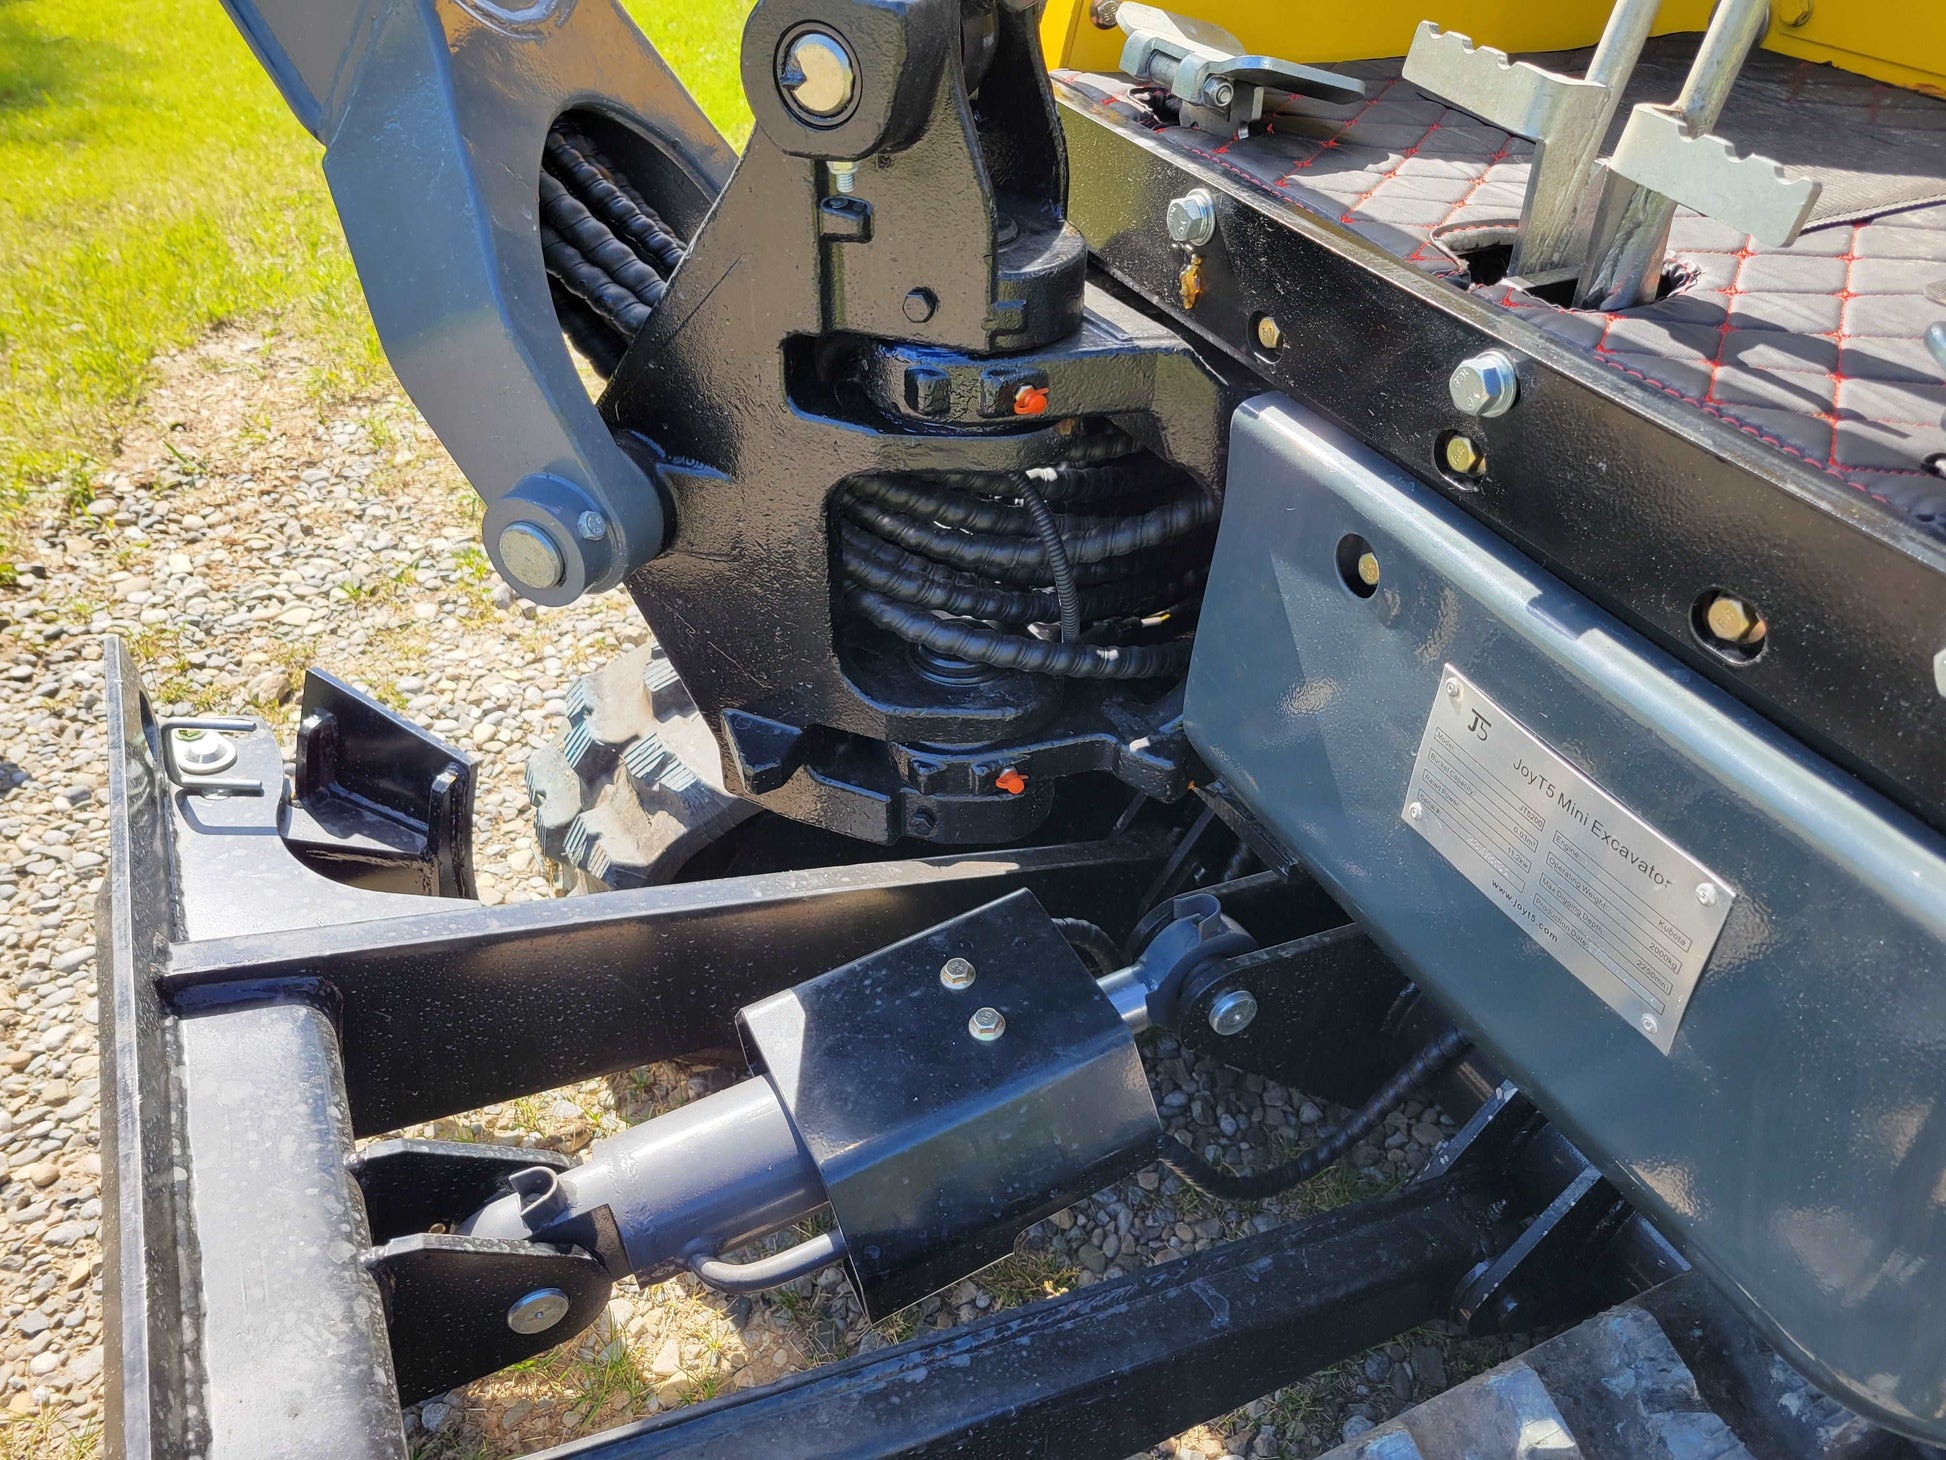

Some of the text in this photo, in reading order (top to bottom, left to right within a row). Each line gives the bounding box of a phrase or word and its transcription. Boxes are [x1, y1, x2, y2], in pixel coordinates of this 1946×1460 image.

[1437, 731, 1456, 752] Model:
[1430, 752, 1449, 772] Bucket
[1424, 774, 1441, 792] Rated
[1513, 758, 1672, 888] JoyT5 Mini Excavator
[1519, 804, 1543, 828] JT5200
[1555, 834, 1581, 859] Engine:
[1549, 856, 1608, 911] Operating Weight:
[1491, 879, 1558, 942] www.joyt5.com
[1542, 878, 1605, 936] Max Digging Depth:
[1535, 897, 1590, 949] Production Date:
[1658, 920, 1687, 947] Kubota
[1649, 942, 1678, 972] 2000kg
[1636, 960, 1669, 992] 2250mm
